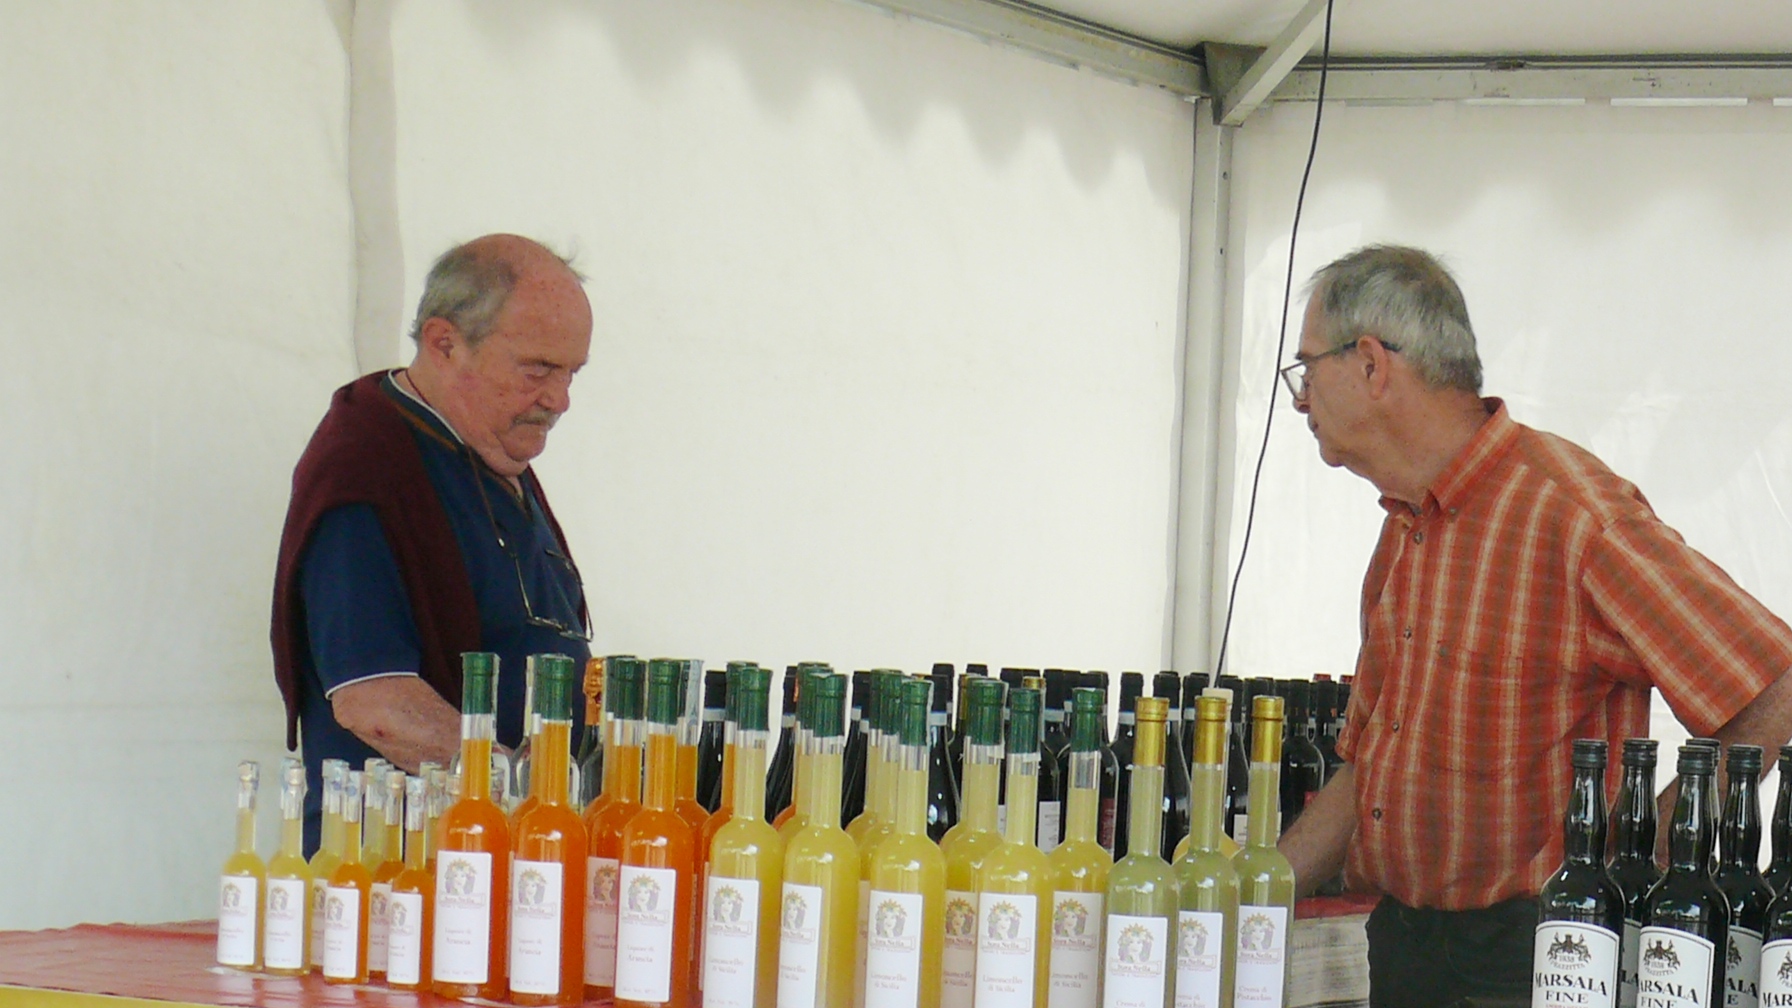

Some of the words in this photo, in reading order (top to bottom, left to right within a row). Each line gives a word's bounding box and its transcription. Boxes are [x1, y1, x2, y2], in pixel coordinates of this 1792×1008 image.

[1535, 972, 1607, 997] MARSALA
[1640, 979, 1699, 1005] ARSALA
[1546, 990, 1589, 1005] FINE
